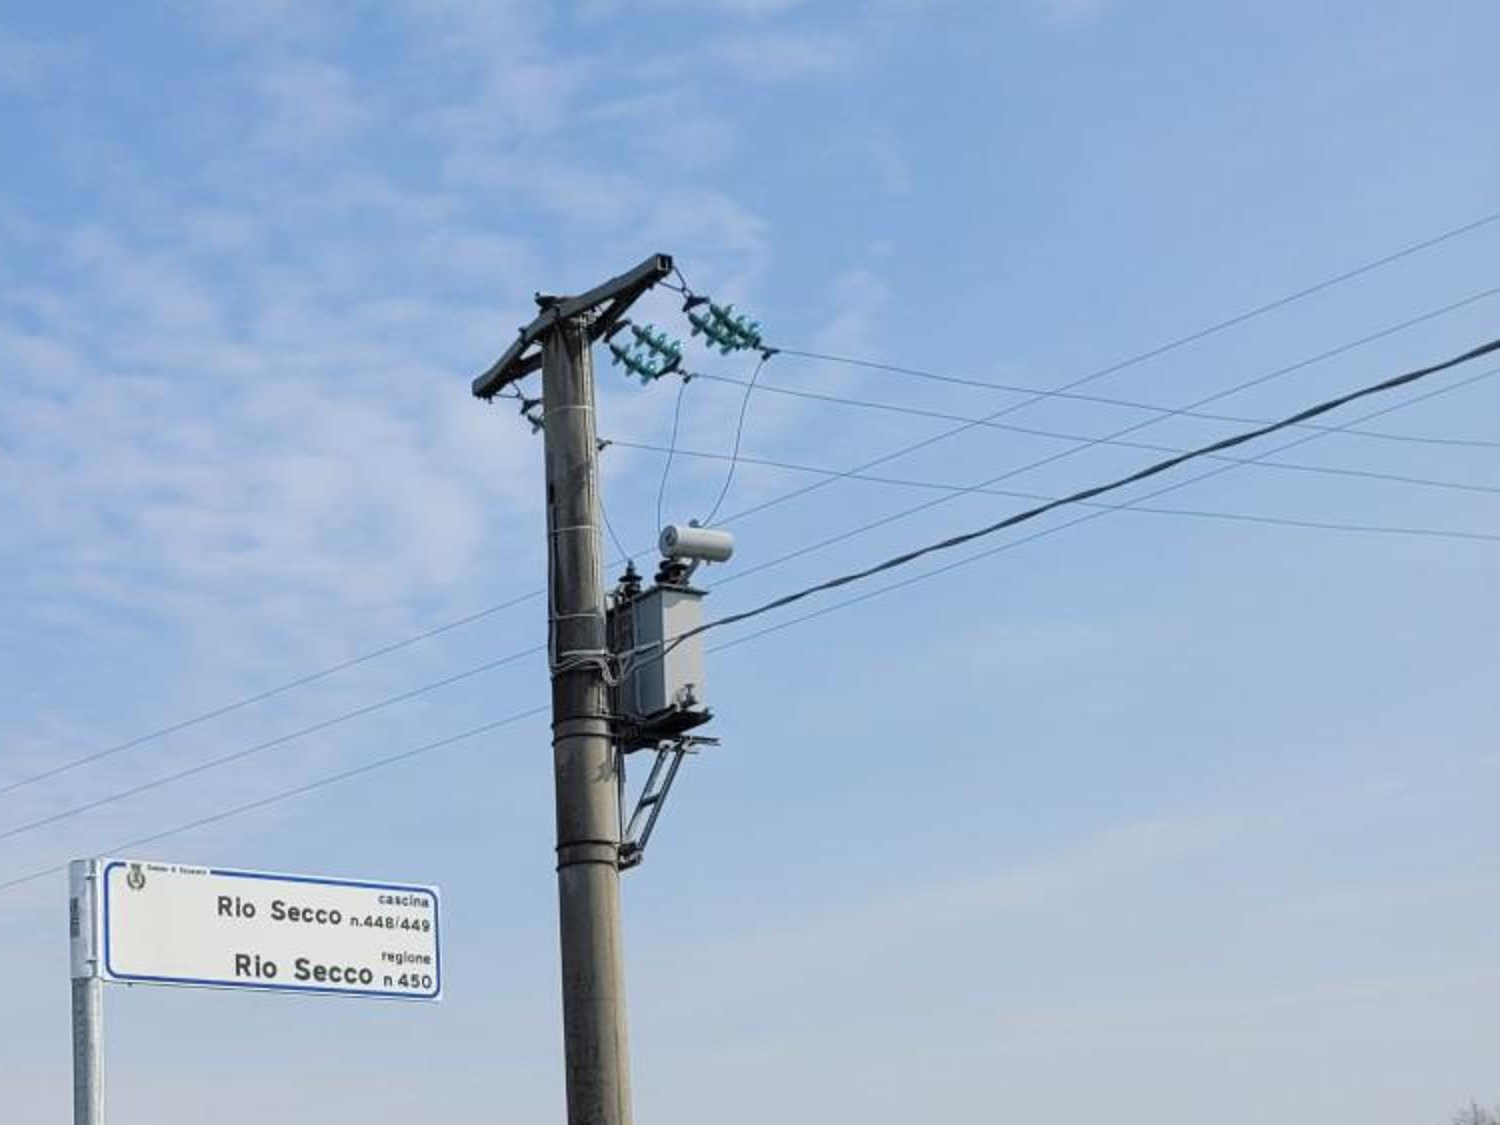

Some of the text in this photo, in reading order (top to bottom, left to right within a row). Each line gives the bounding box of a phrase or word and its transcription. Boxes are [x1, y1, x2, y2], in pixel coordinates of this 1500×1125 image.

[217, 895, 256, 918] Rio
[270, 900, 342, 925] Secco
[378, 893, 429, 908] cascina
[235, 953, 277, 978] Rio
[294, 957, 373, 985] Secco
[381, 951, 432, 965] regione
